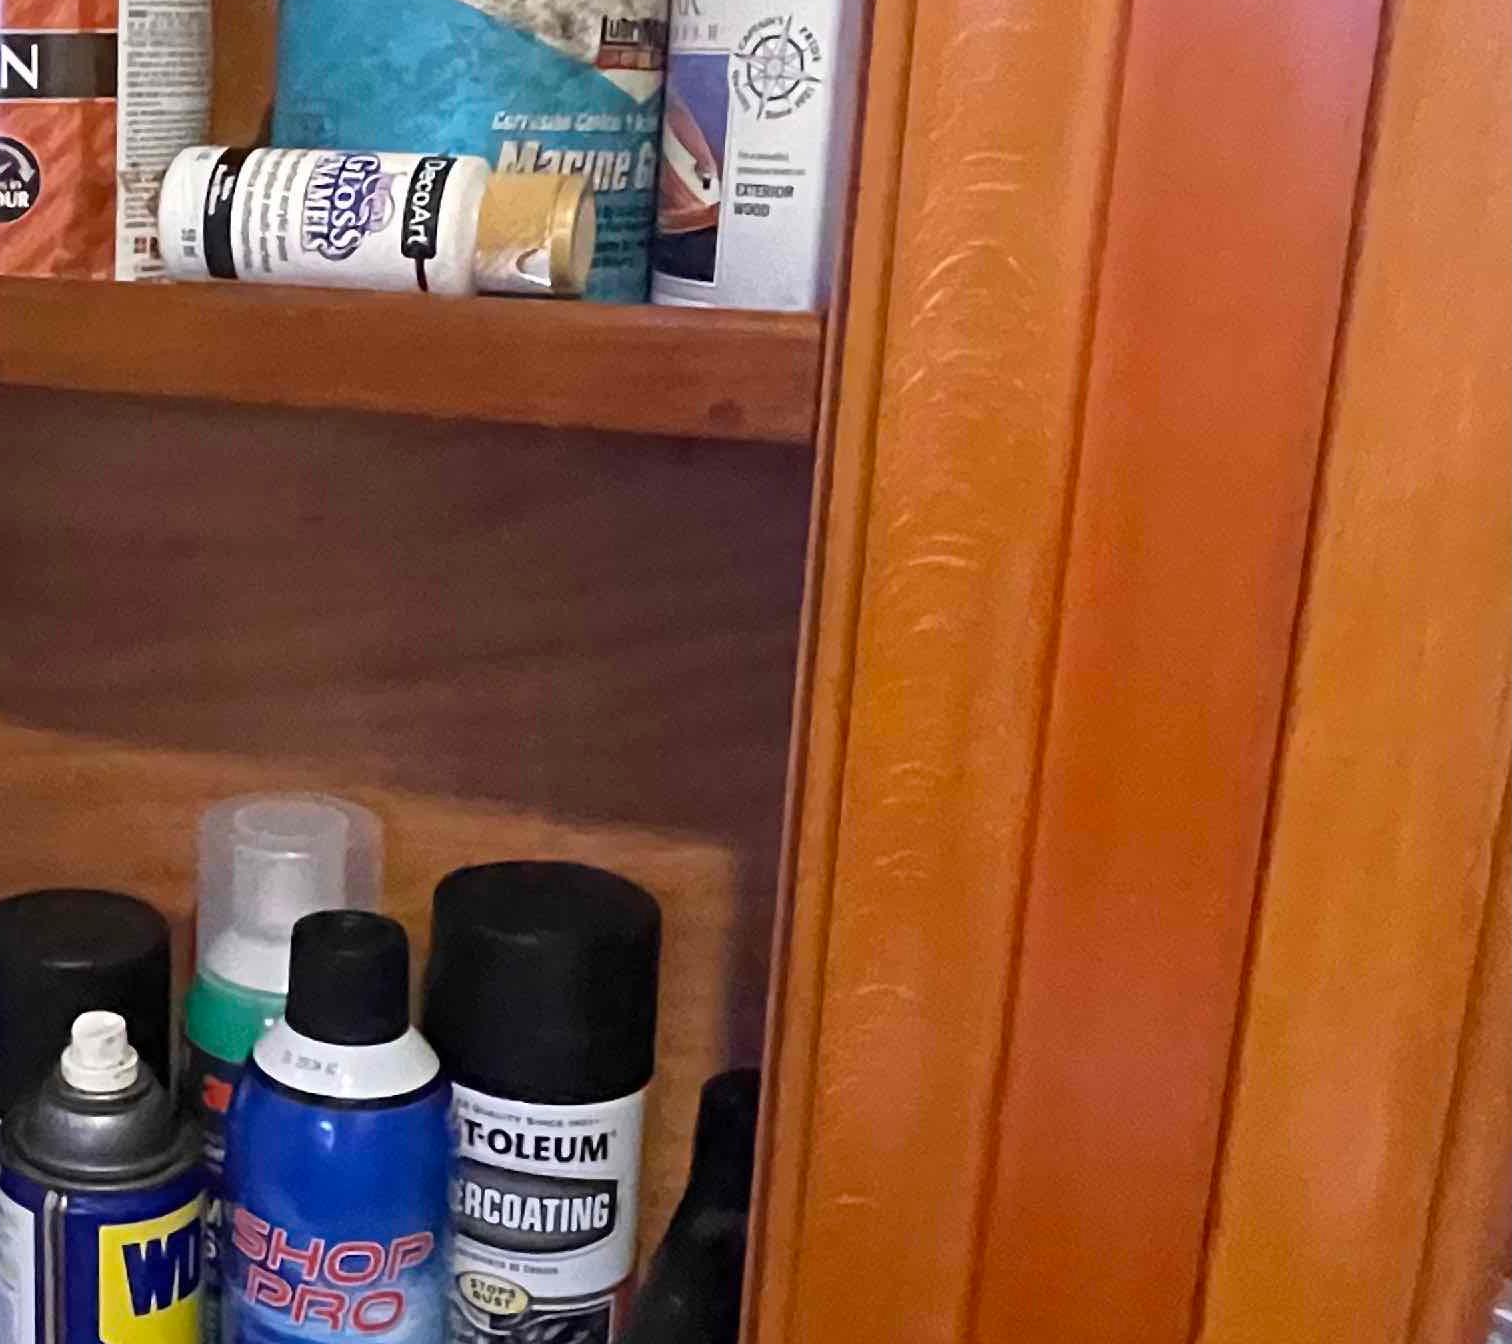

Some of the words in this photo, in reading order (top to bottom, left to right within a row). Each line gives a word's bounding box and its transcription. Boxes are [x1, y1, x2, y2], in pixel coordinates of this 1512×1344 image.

[331, 154, 378, 252] GLOSS
[406, 156, 446, 246] DecoArt
[733, 202, 771, 217] WOOD
[734, 182, 794, 198] EXTERIOR
[463, 1118, 609, 1163] T-OLEUM
[231, 1206, 435, 1287] SHOP
[245, 1262, 407, 1334] PRO
